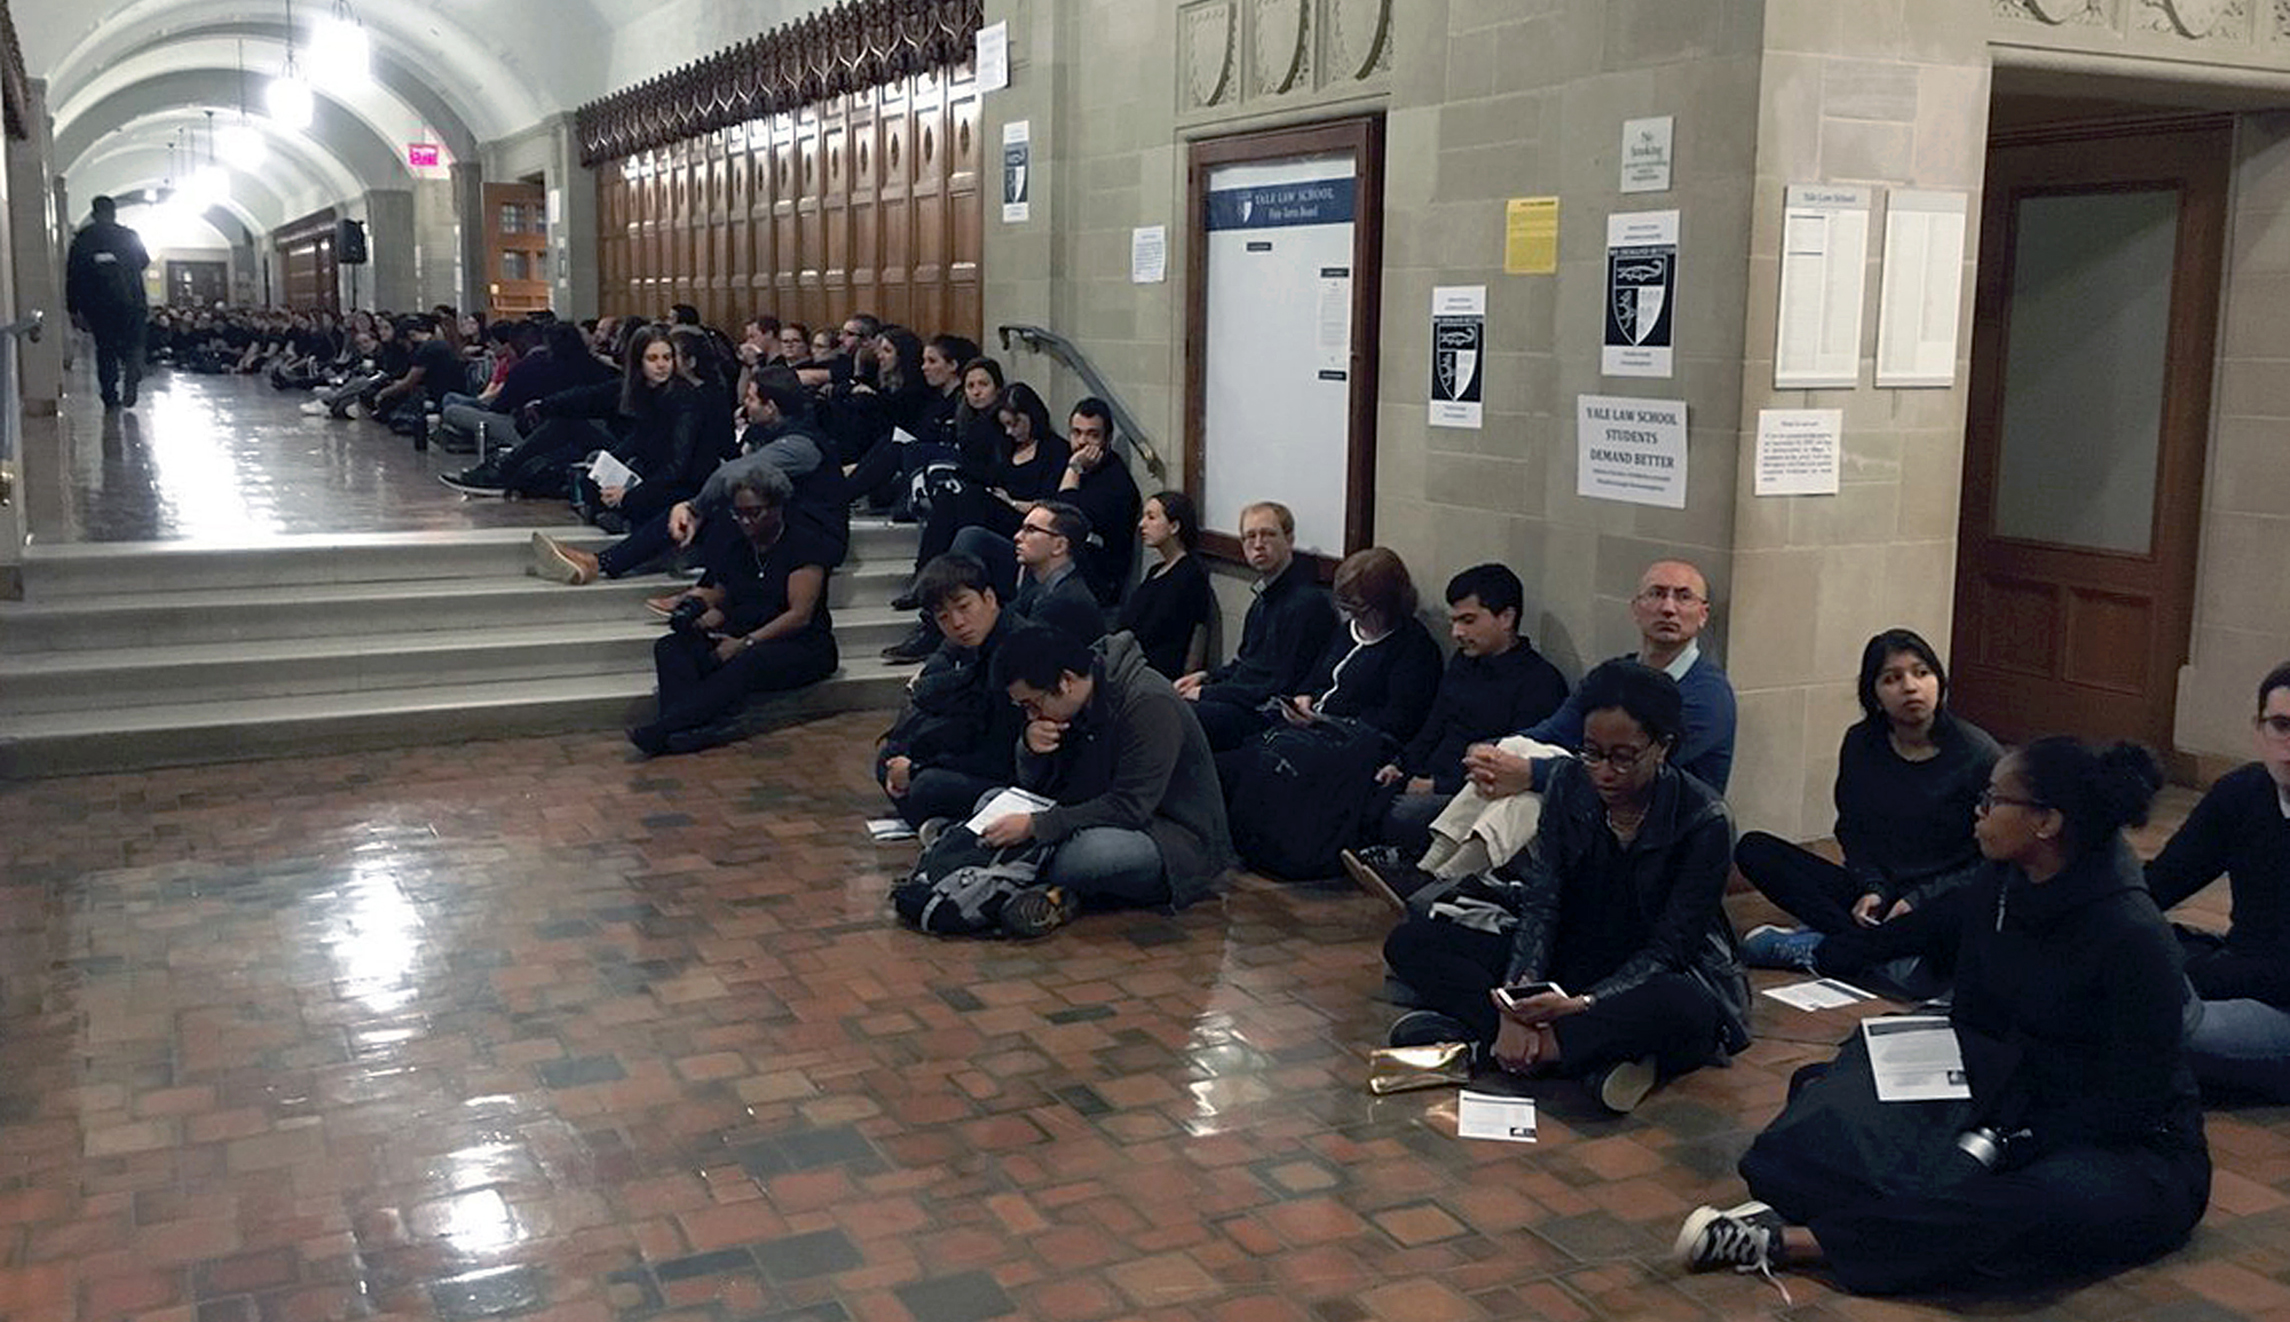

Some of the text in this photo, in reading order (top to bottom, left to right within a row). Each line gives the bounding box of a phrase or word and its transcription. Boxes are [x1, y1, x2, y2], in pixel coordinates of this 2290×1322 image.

[1254, 186, 1335, 205] YALE LAW SCHOOL
[1586, 407, 1677, 425] YALE LAW SCHOOL
[1606, 429, 1658, 444] STUDENTS
[1590, 448, 1674, 469] DEMAND BETTER
